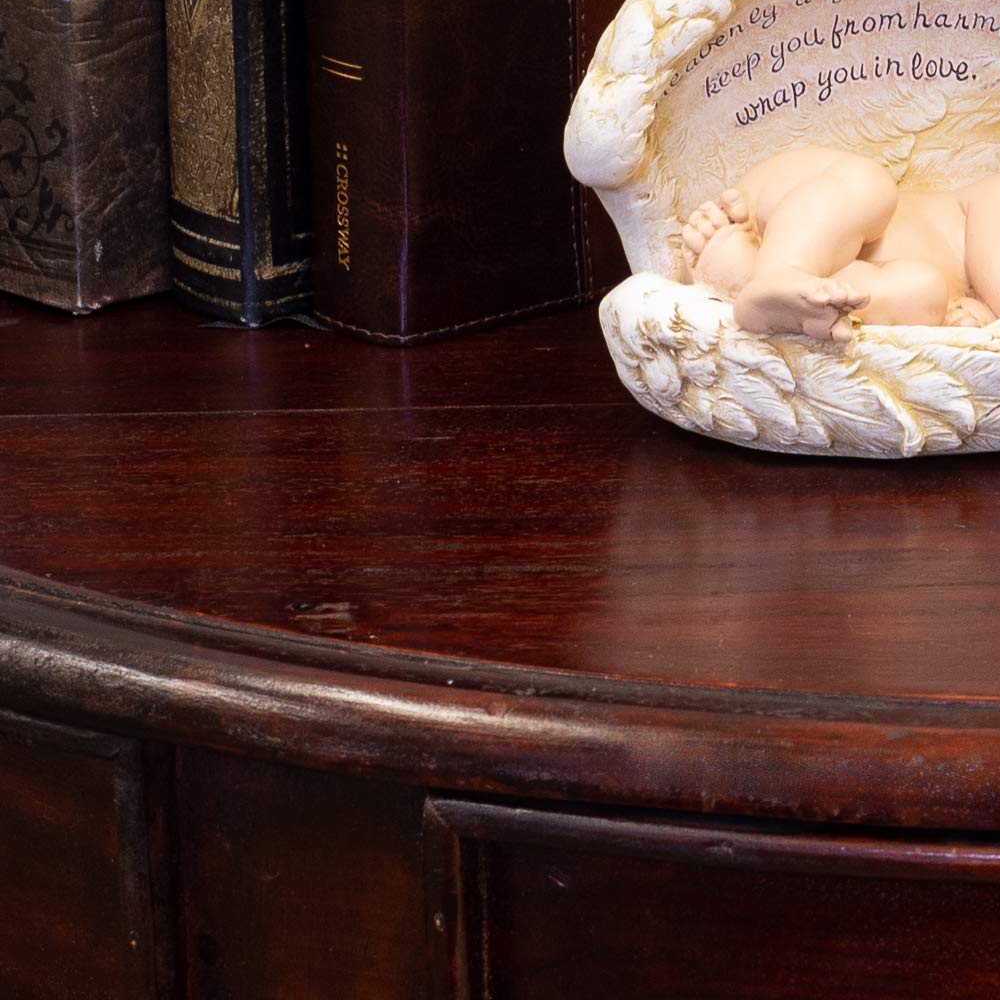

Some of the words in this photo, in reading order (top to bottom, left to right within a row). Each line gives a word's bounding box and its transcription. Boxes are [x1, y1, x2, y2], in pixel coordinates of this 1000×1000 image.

[662, 4, 776, 96] eavenly
[705, 52, 761, 98] keep
[770, 28, 825, 73] you
[831, 14, 907, 50] from
[735, 80, 806, 127] wrap
[817, 62, 868, 103] you
[874, 55, 904, 79] in
[911, 51, 977, 82] love.
[335, 163, 350, 272] CROSSWAY
